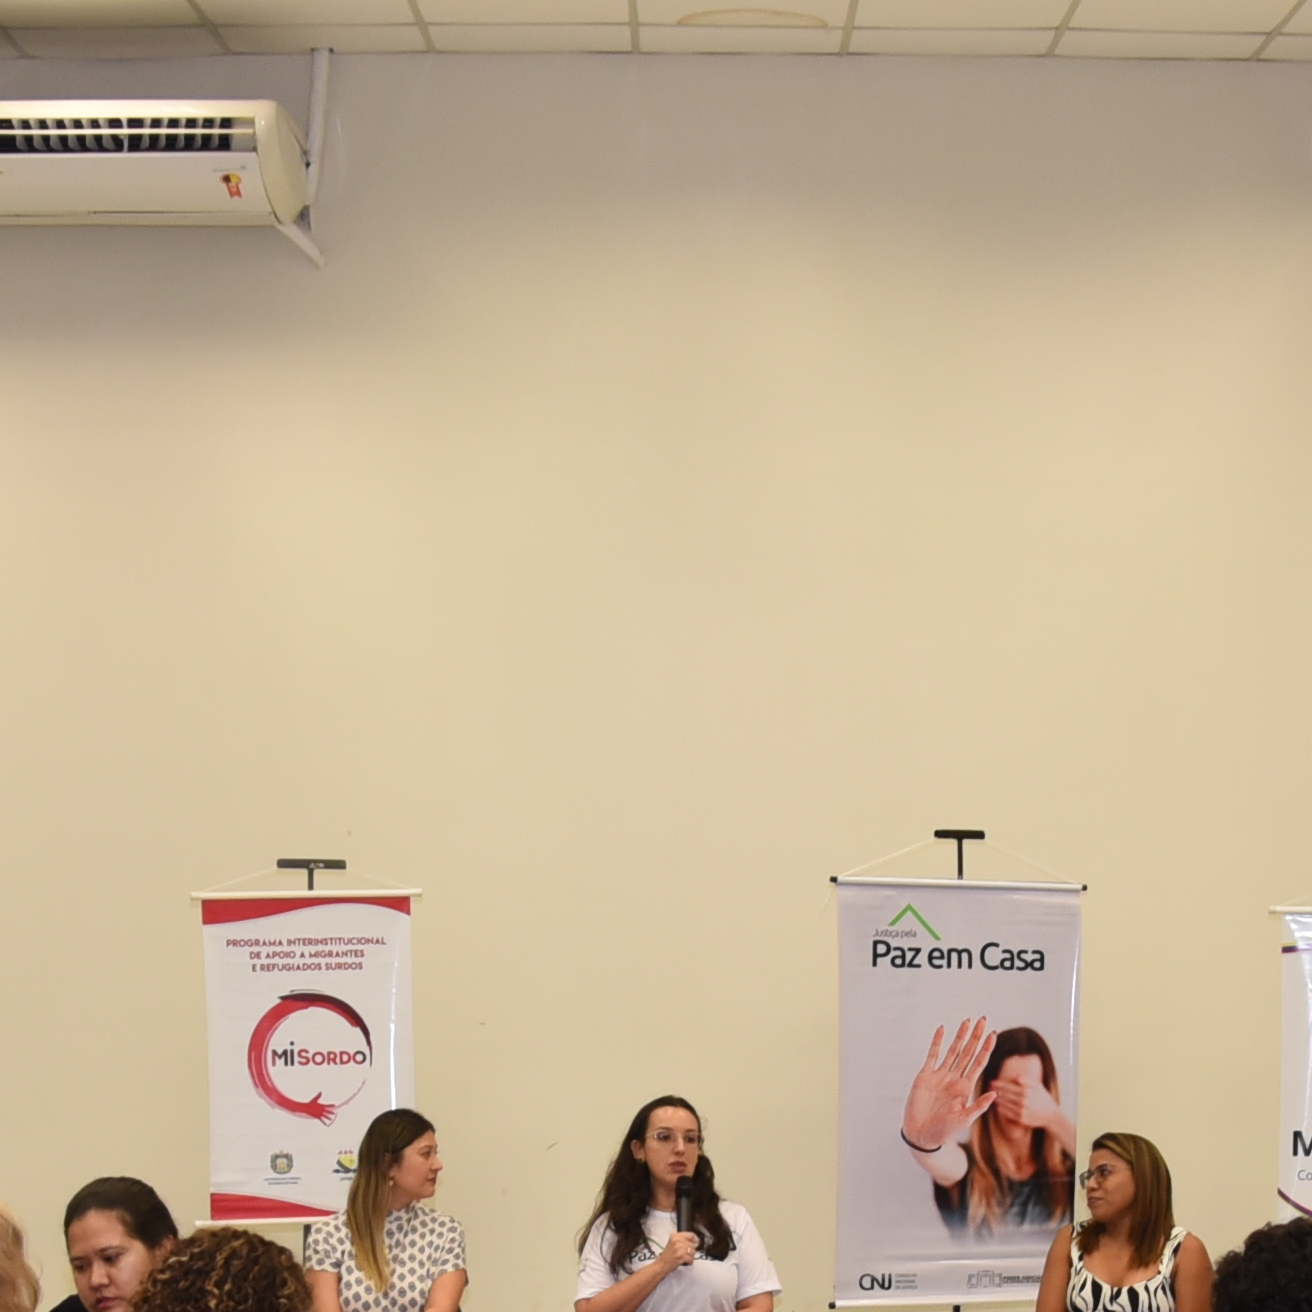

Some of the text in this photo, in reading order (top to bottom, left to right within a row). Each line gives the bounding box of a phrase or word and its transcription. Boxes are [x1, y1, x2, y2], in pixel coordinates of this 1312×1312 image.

[900, 928, 918, 939] pela
[226, 936, 387, 948] PROGRAMA INTERINSTITUCIONAL
[249, 949, 365, 960] DE APOIO A MIGRANTES
[872, 939, 1045, 971] Paz em Casa
[251, 961, 364, 973] E REFUGIADOS SURDOS
[858, 1272, 892, 1291] CNJ
